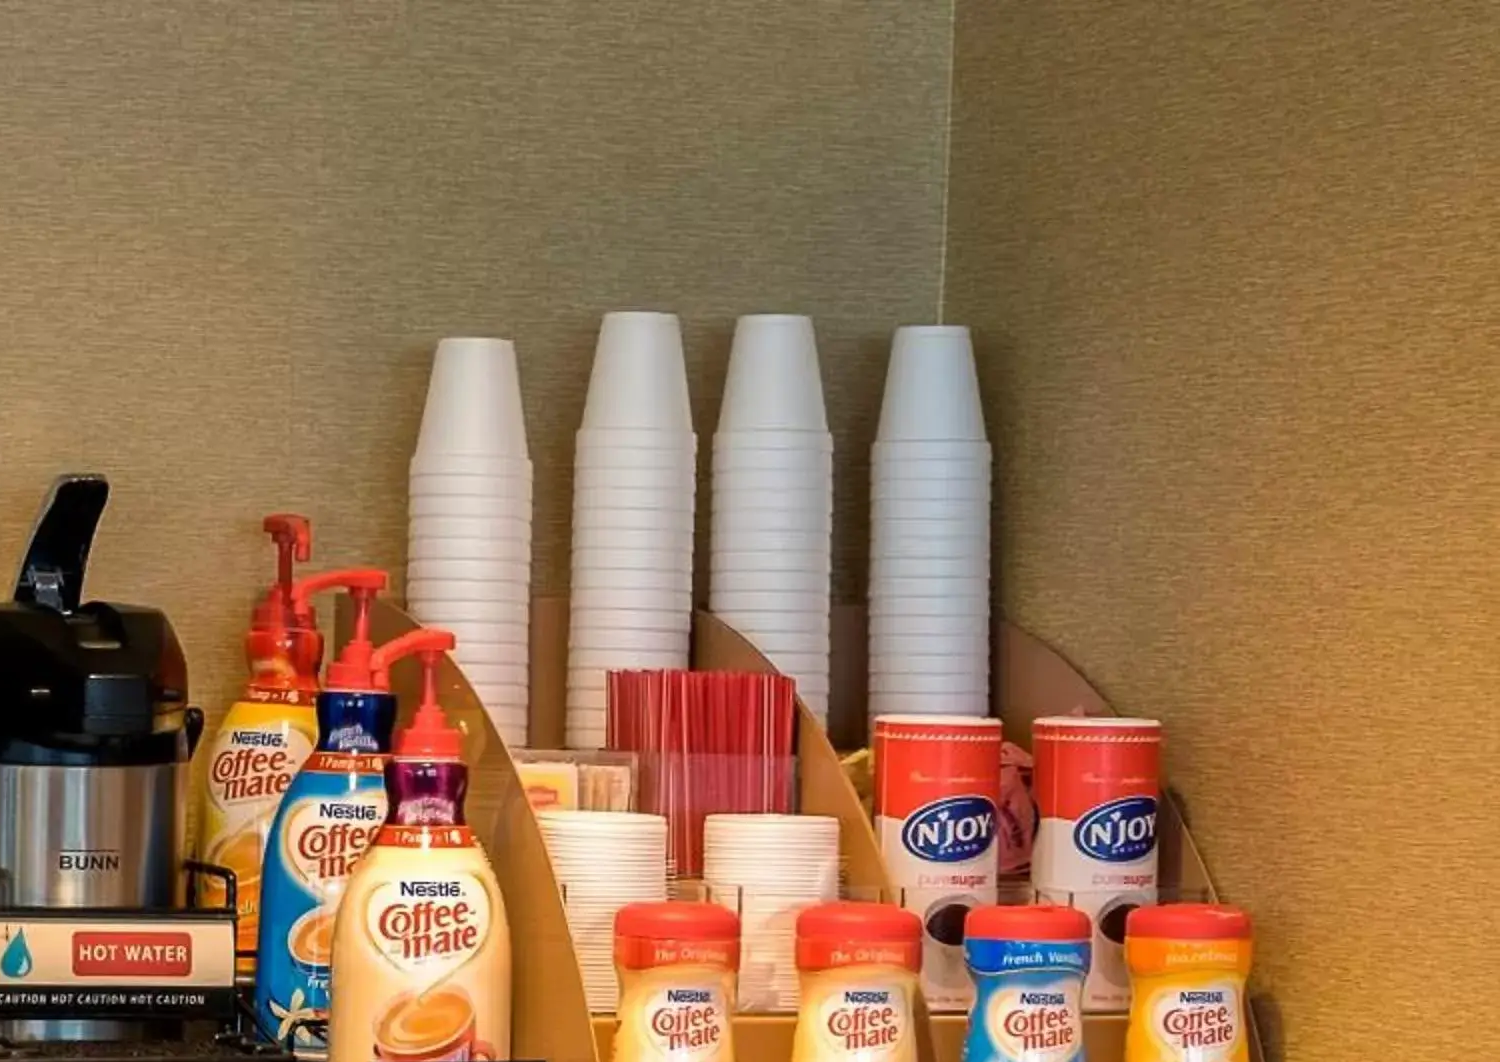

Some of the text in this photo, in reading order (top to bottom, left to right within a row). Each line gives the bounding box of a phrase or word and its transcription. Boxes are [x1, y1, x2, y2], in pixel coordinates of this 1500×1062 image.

[224, 773, 291, 800] mate
[319, 803, 377, 820] Nestlé
[59, 855, 119, 871] BUNN
[400, 881, 460, 897] Nestlé
[79, 944, 187, 962] HOT WATER
[403, 925, 477, 958] mate
[51, 993, 72, 1004] HOT
[77, 993, 126, 1005] CAUTION
[130, 993, 152, 1005] HOT
[156, 994, 205, 1005] CAUTION
[670, 1024, 720, 1050] mate
[846, 1025, 898, 1050] mate
[1024, 1027, 1073, 1050] mate
[1182, 1024, 1233, 1049] mate
